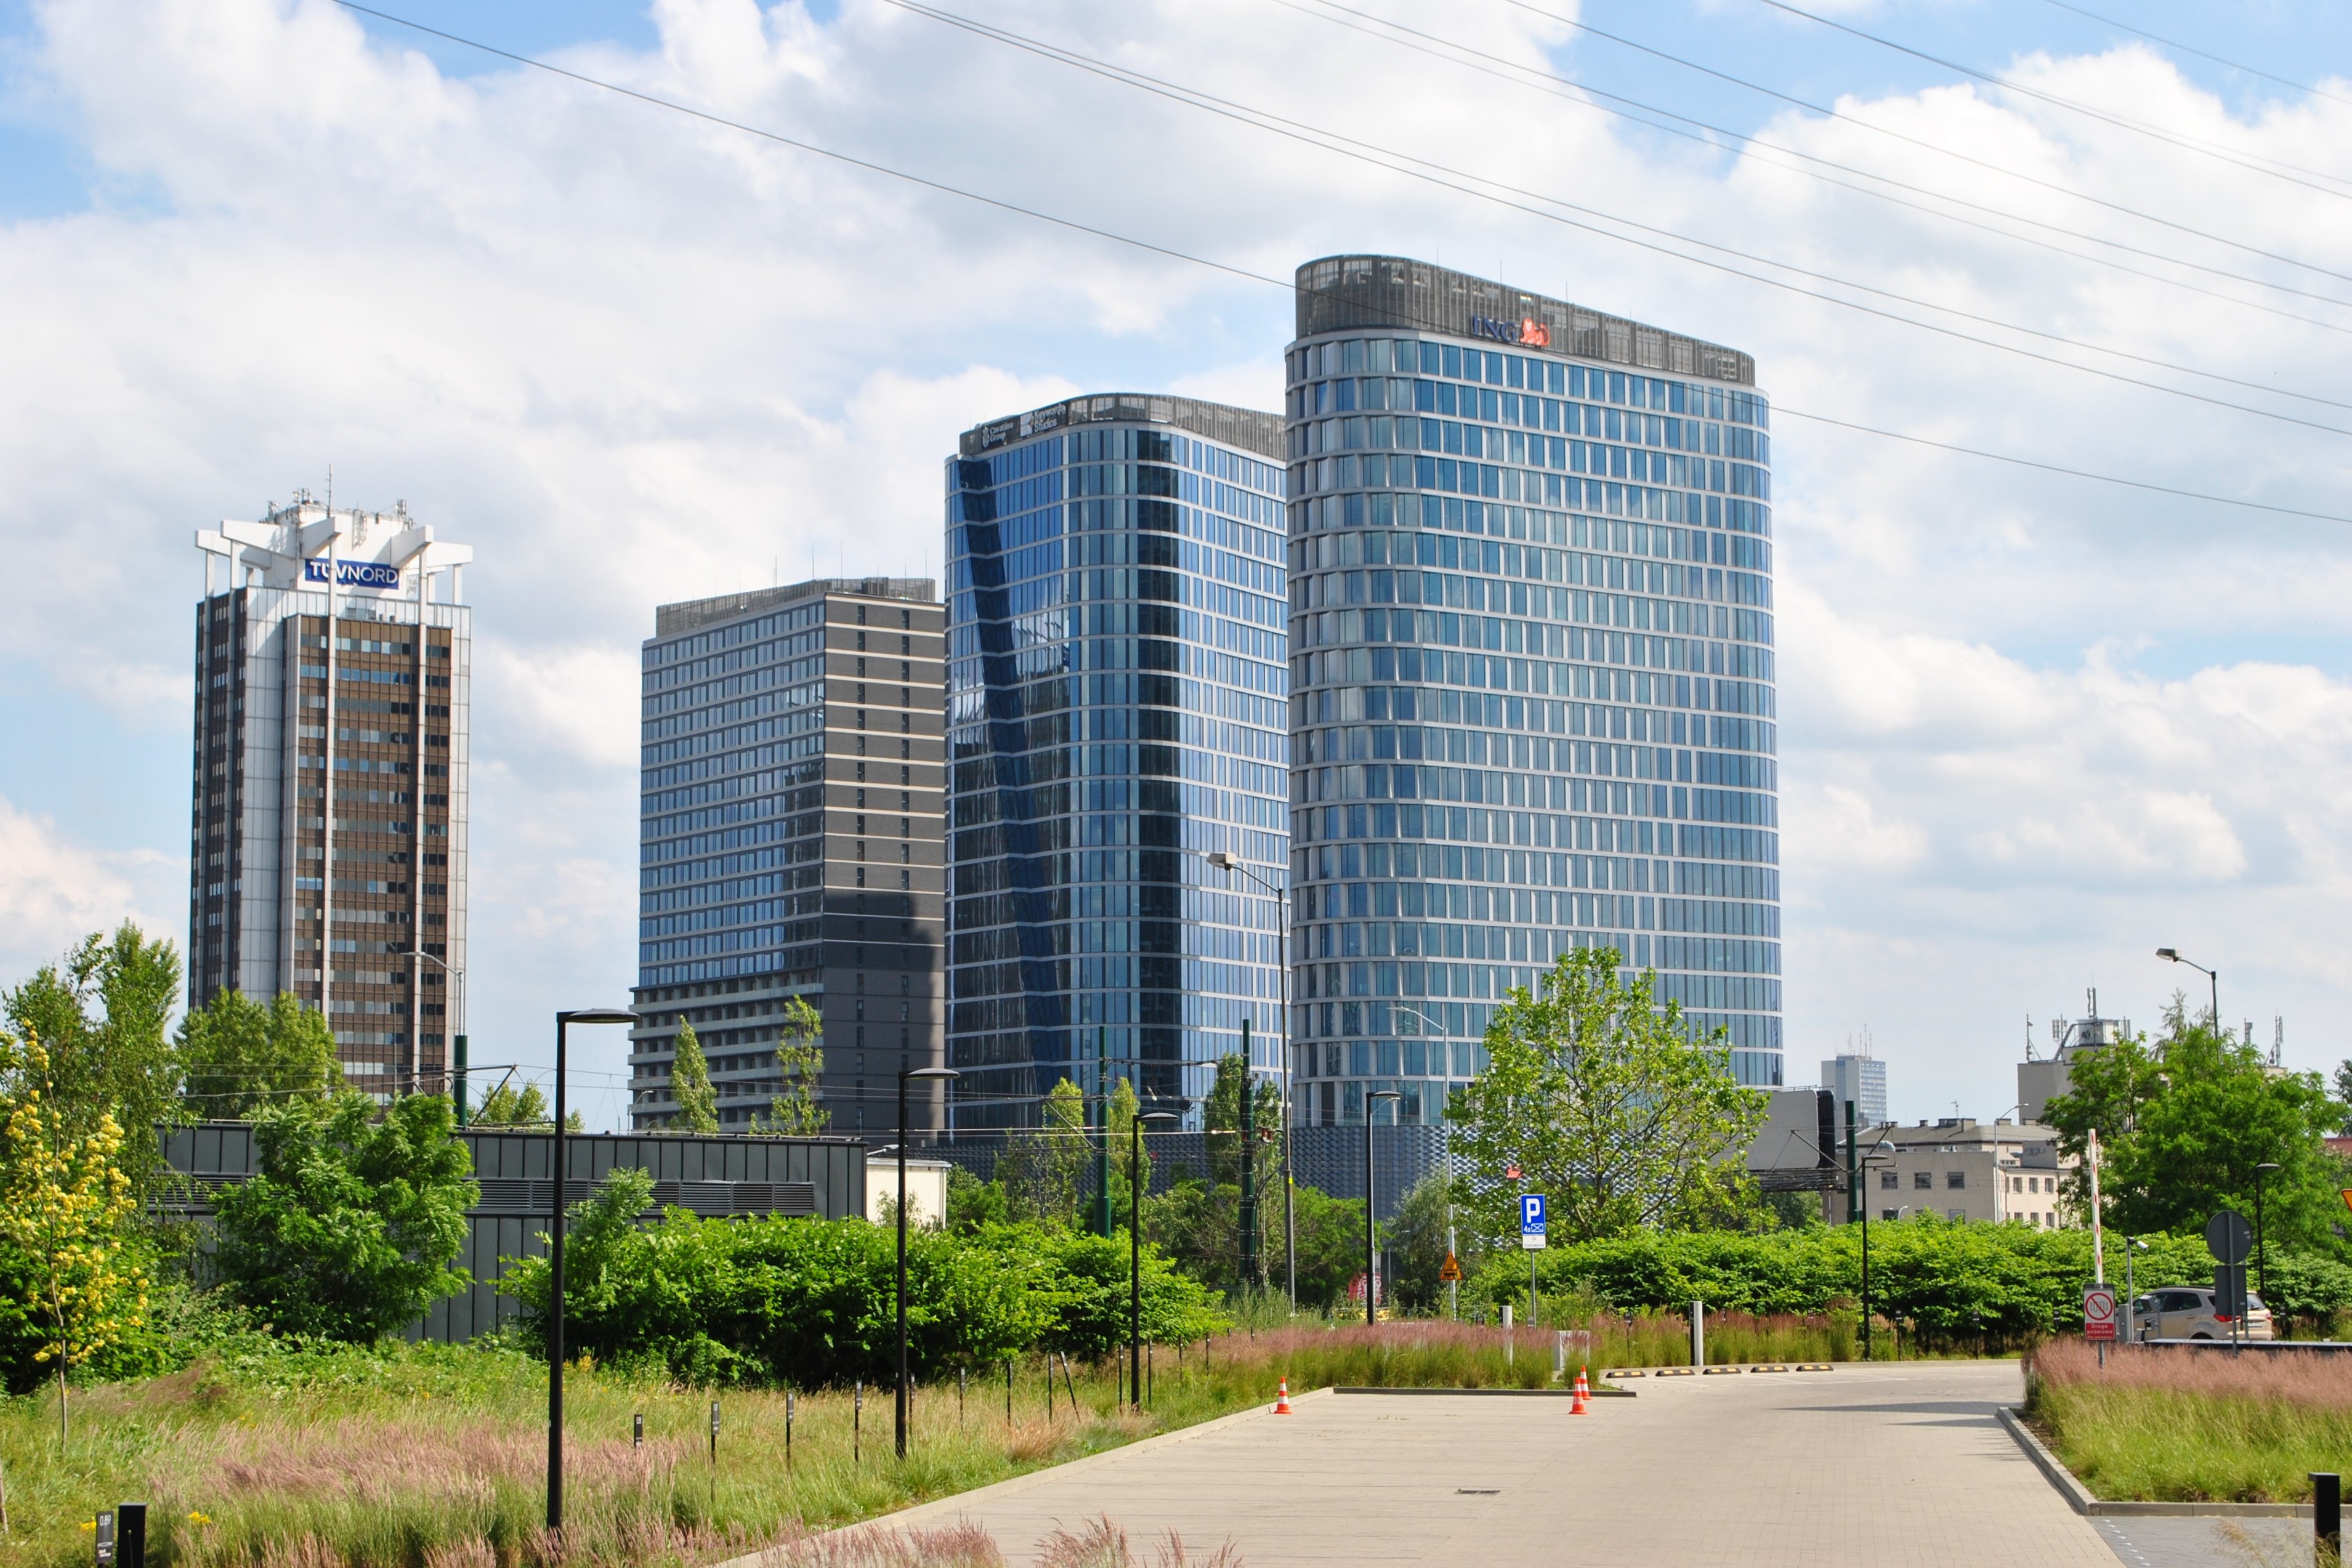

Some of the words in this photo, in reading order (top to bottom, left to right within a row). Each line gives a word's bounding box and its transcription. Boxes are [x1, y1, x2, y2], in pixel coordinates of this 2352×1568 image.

[1471, 314, 1517, 342] ING
[1034, 403, 1066, 419] Keywords
[990, 421, 1014, 435] Cavatina
[1034, 418, 1057, 432] Studios
[990, 432, 1006, 442] Group
[1526, 1198, 1540, 1224] P
[99, 1514, 111, 1526] 0.89
